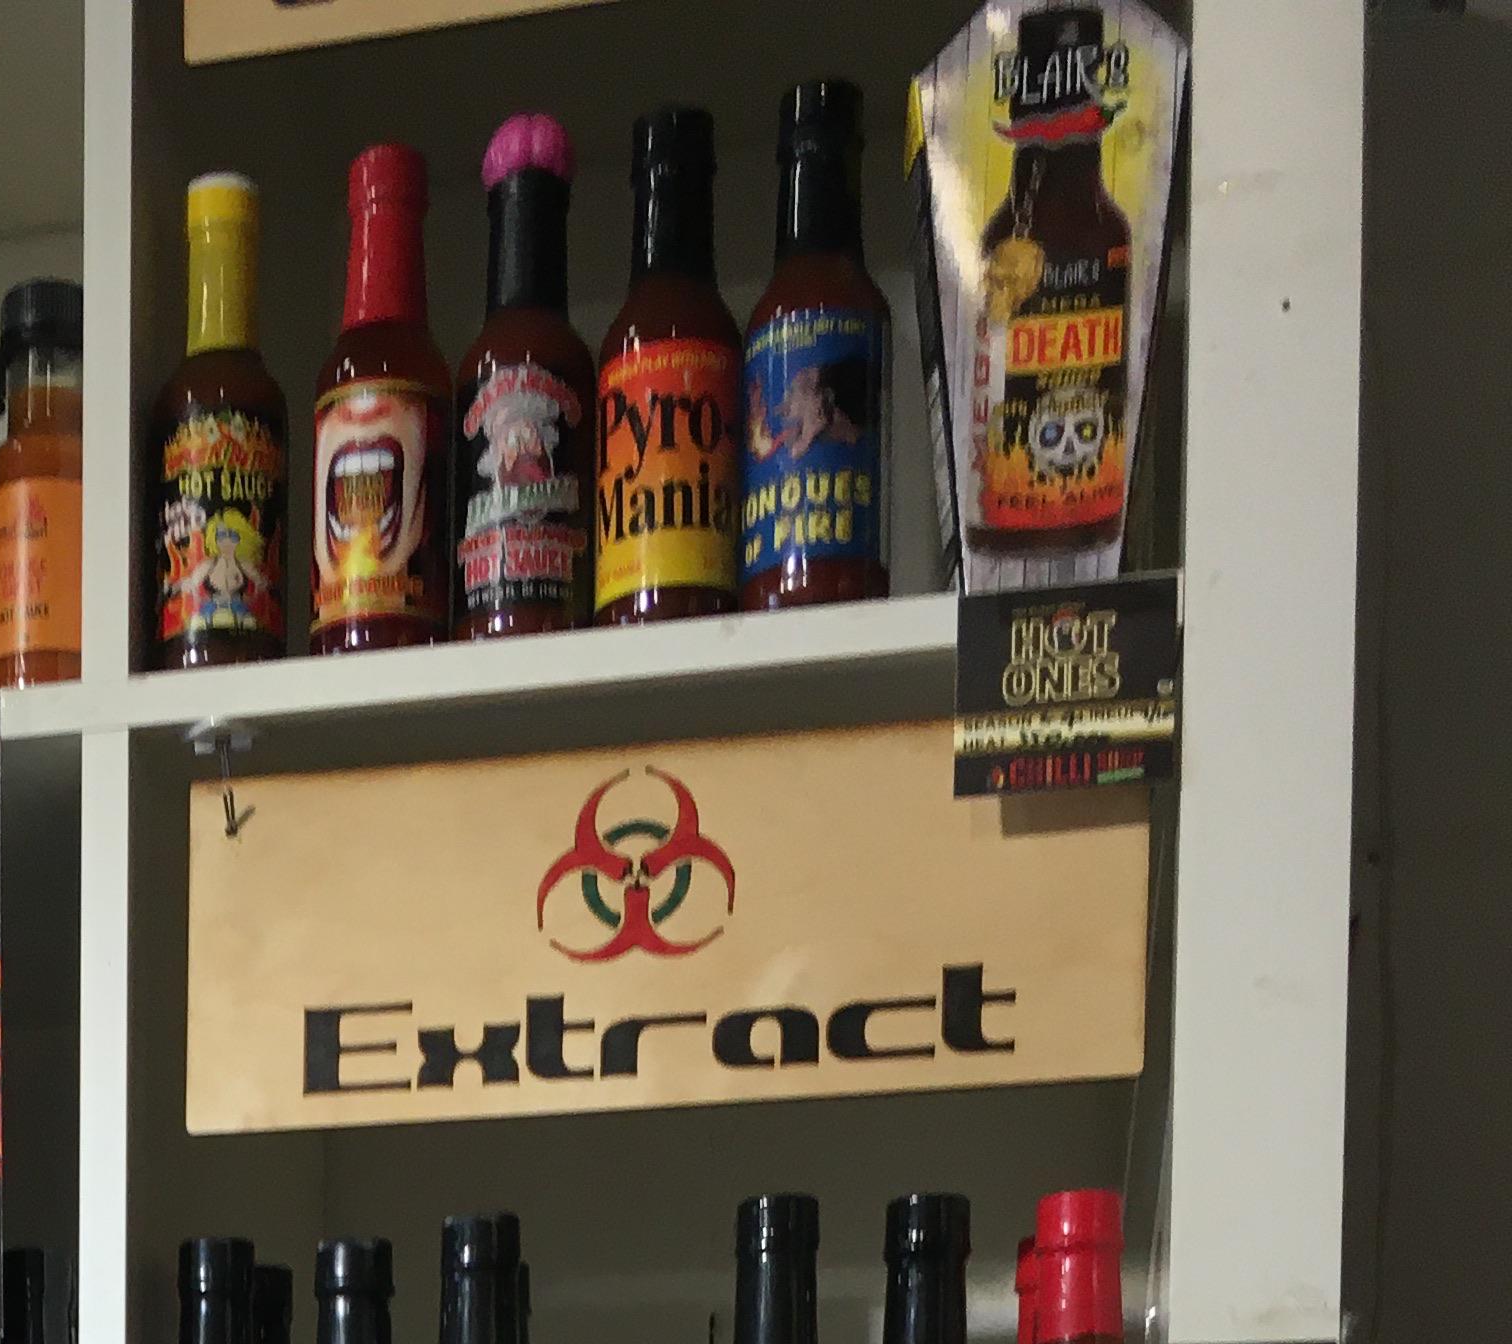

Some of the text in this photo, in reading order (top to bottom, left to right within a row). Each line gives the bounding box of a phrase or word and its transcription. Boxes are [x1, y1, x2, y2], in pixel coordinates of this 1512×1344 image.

[1010, 314, 1120, 362] DEATH
[599, 384, 725, 479] Pyro
[597, 464, 736, 546] Mania
[1010, 605, 1116, 663] HOT
[1002, 657, 1120, 703] ONES
[301, 963, 1017, 1097] Extract
